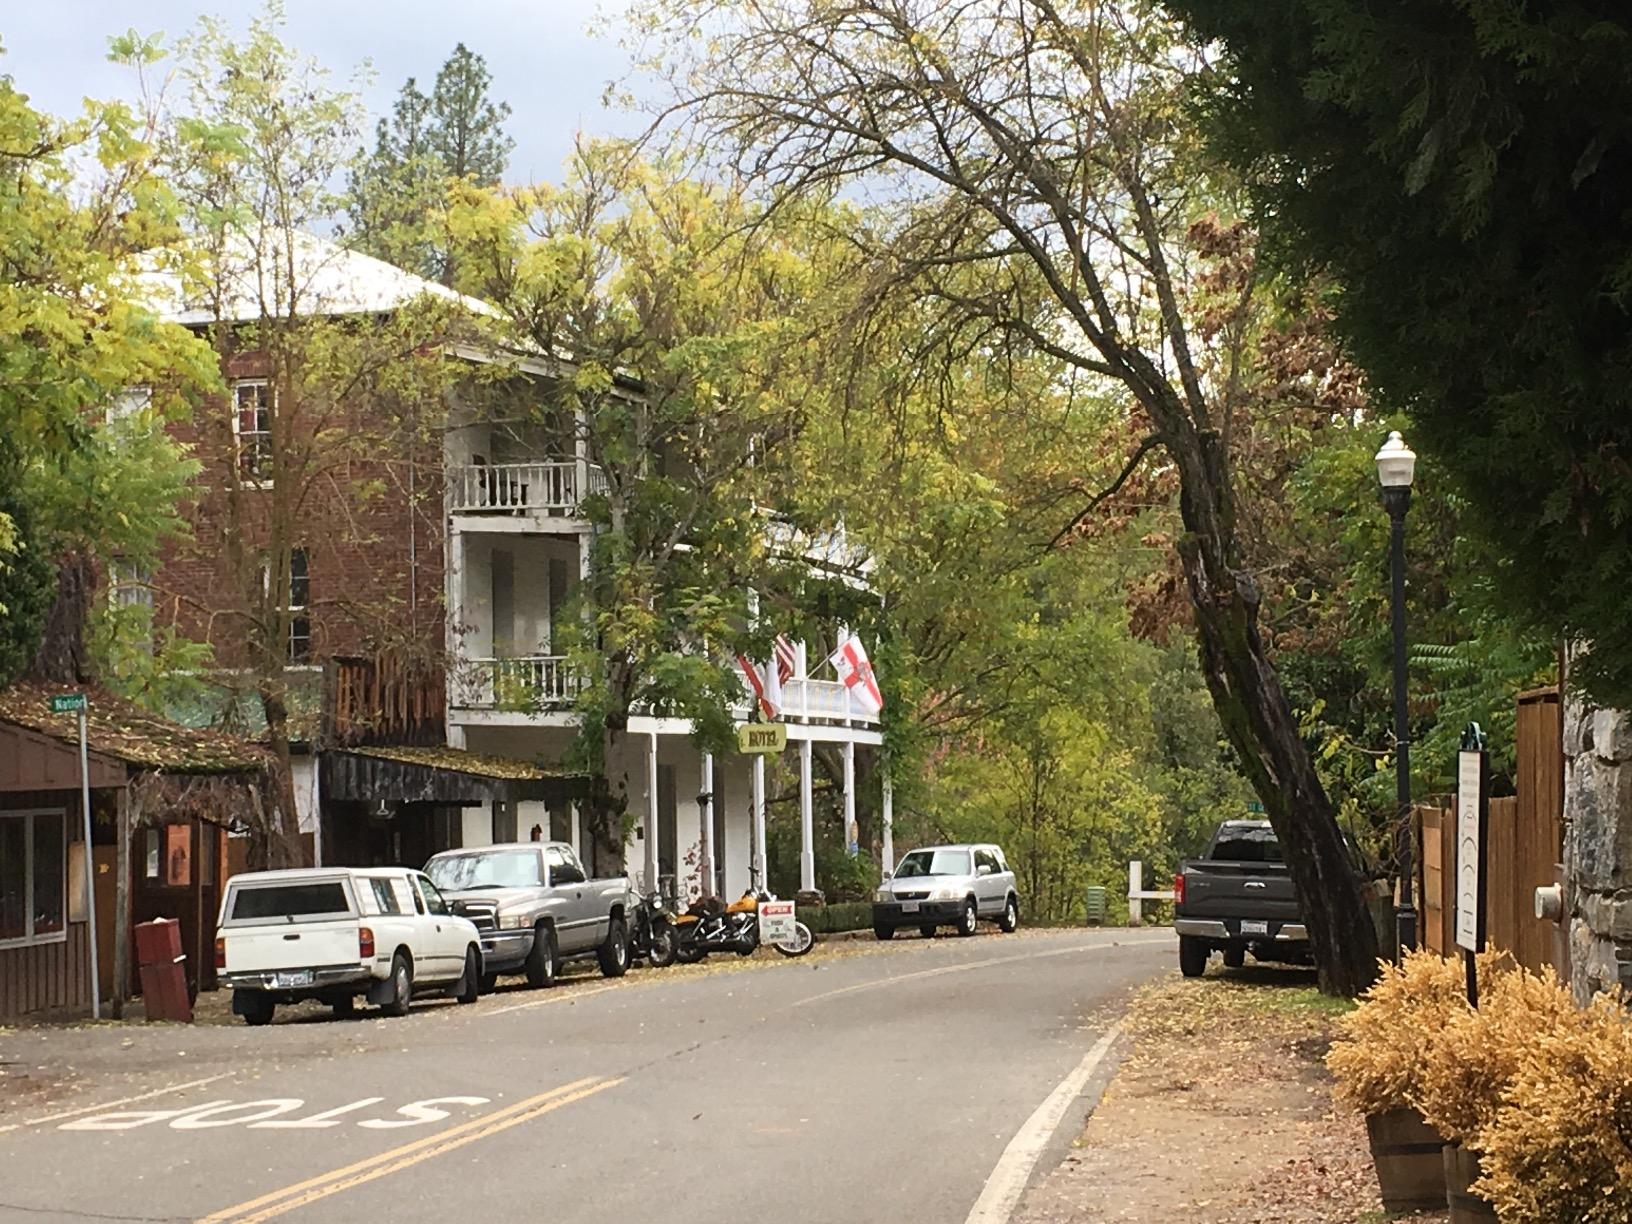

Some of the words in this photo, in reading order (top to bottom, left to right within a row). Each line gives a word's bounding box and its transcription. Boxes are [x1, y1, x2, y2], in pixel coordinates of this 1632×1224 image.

[749, 730, 779, 747] HOTEL
[766, 906, 789, 914] OPEN
[57, 1097, 491, 1130] STOP
